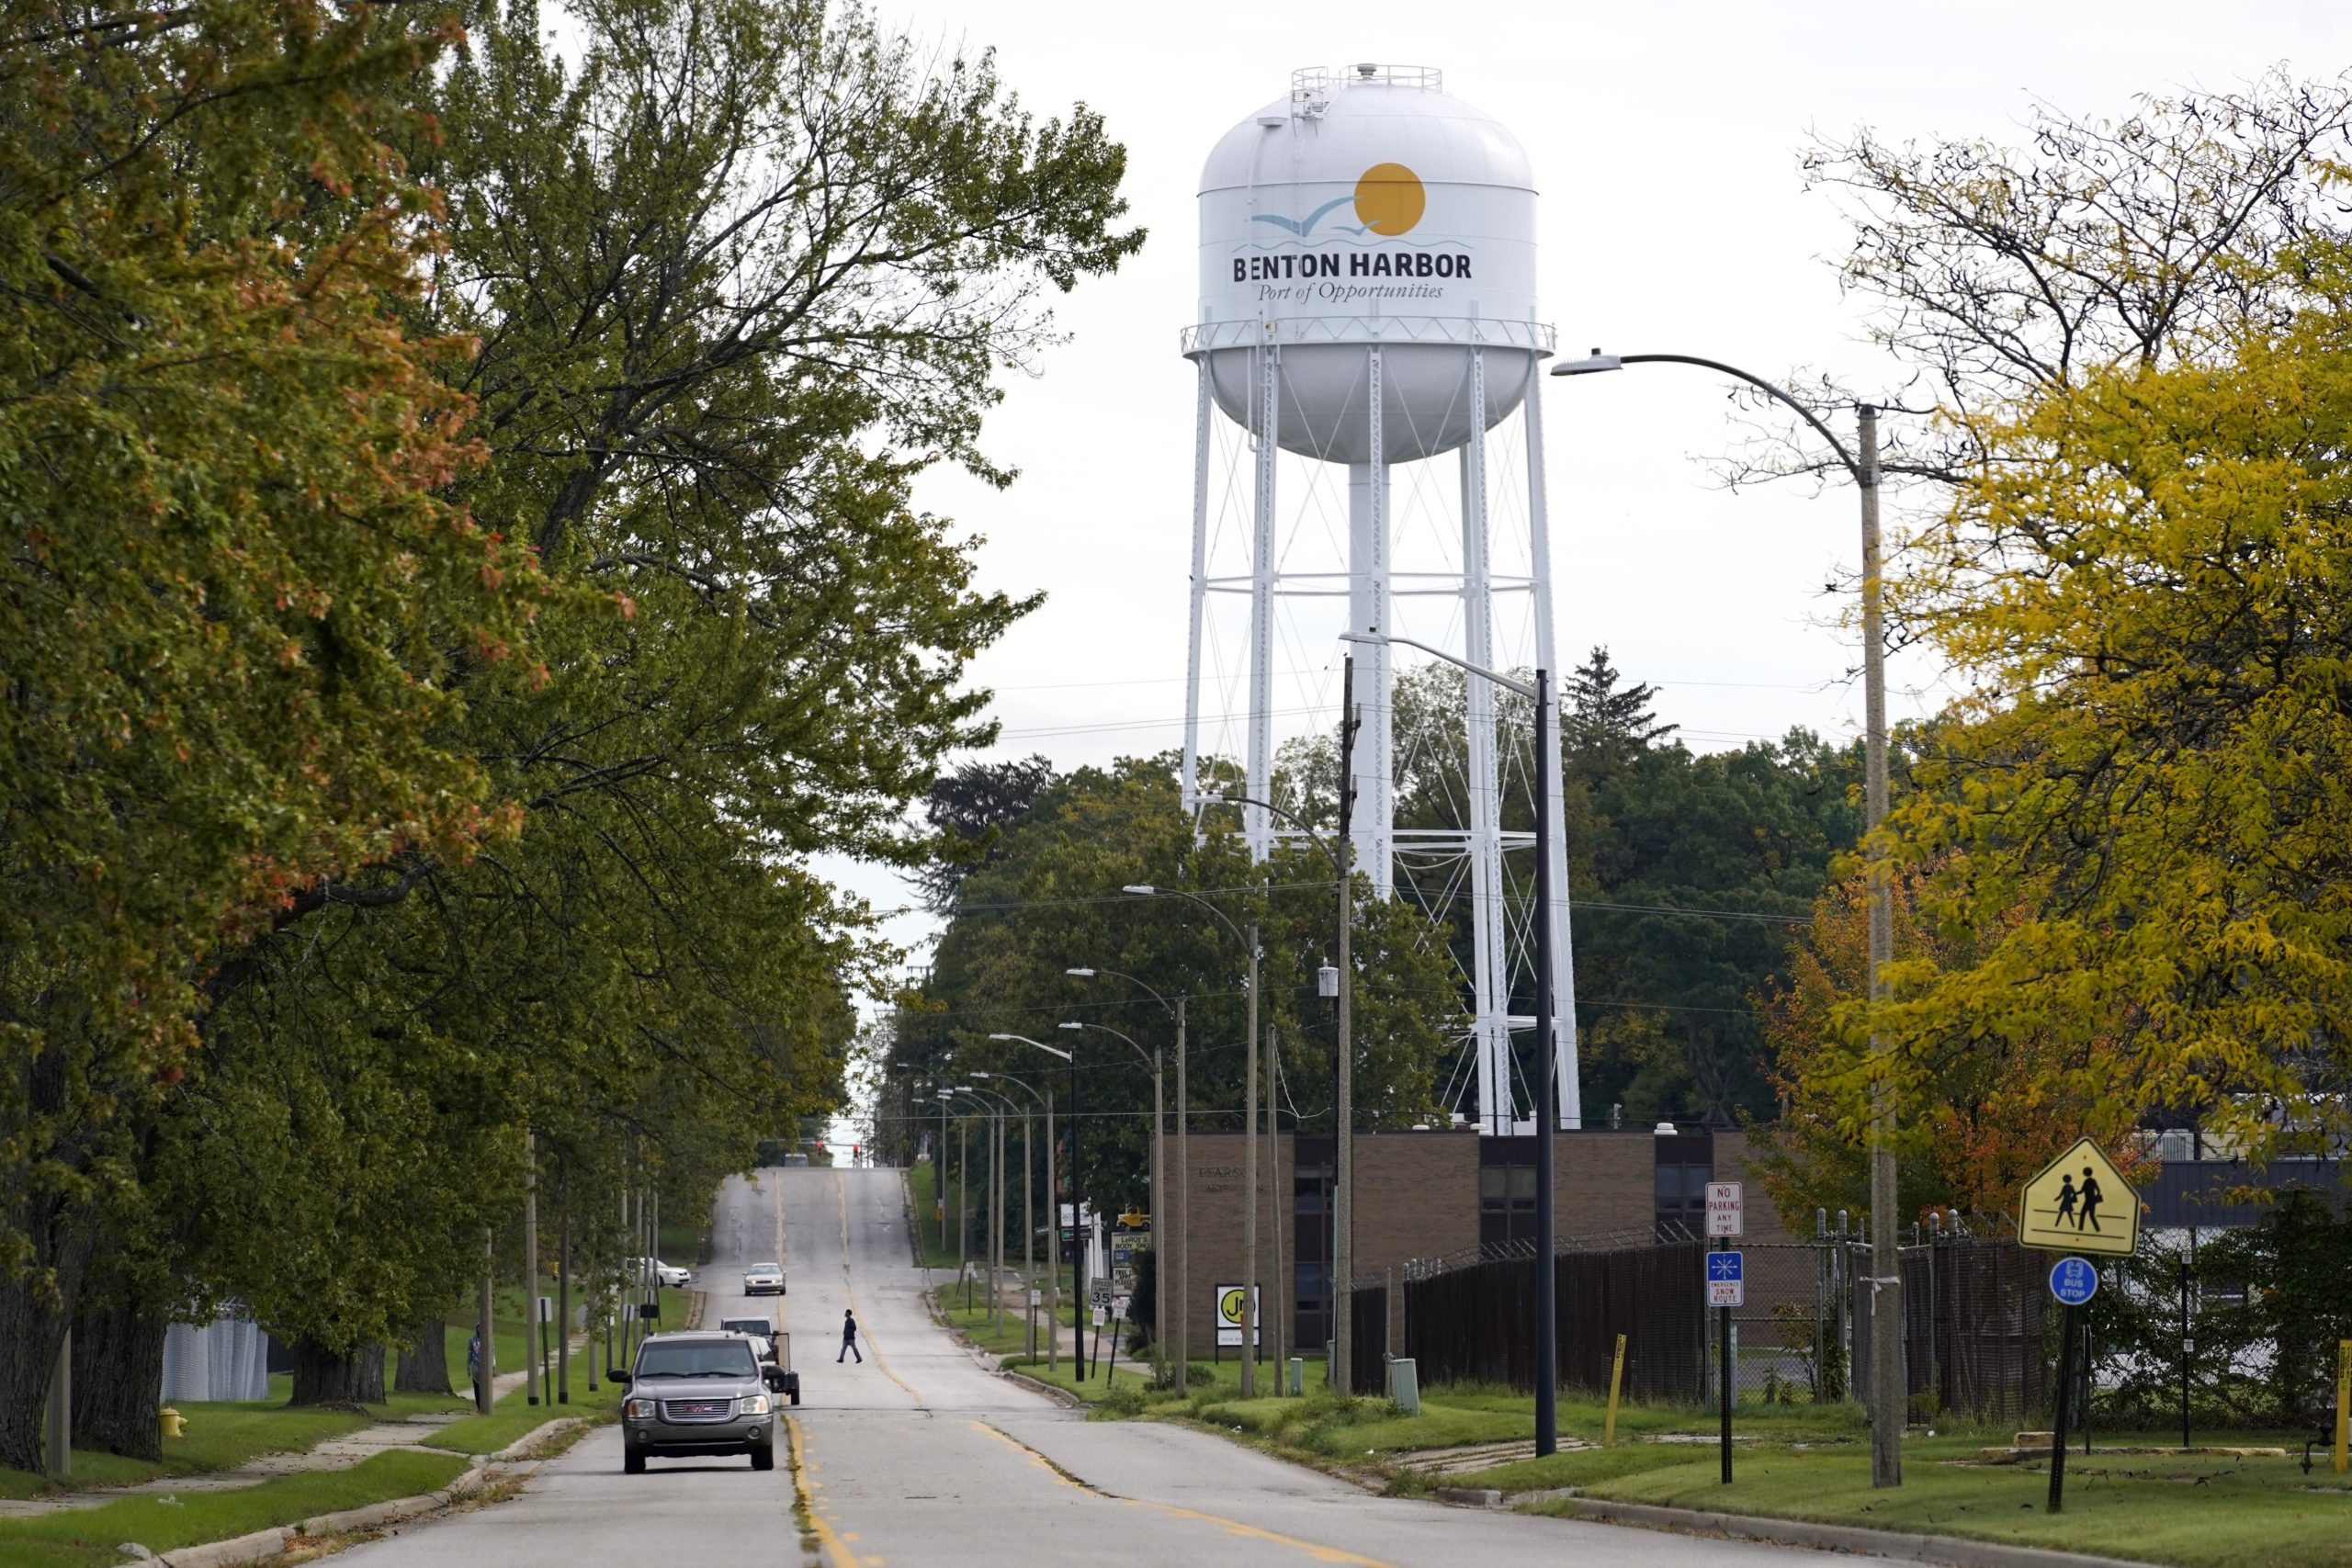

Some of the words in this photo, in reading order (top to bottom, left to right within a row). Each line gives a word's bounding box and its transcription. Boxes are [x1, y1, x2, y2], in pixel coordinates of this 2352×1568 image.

[1234, 253, 1340, 282] BENTON
[1350, 253, 1472, 279] HARBOR
[1259, 284, 1291, 301] Port
[1295, 282, 1316, 305] of
[1319, 282, 1444, 303] Opportunities
[1718, 1188, 1730, 1198] NO
[1709, 1201, 1740, 1211] PARKING
[2064, 1278, 2083, 1287] BUS
[1092, 1292, 1110, 1303] 35
[2060, 1288, 2085, 1297] STOP
